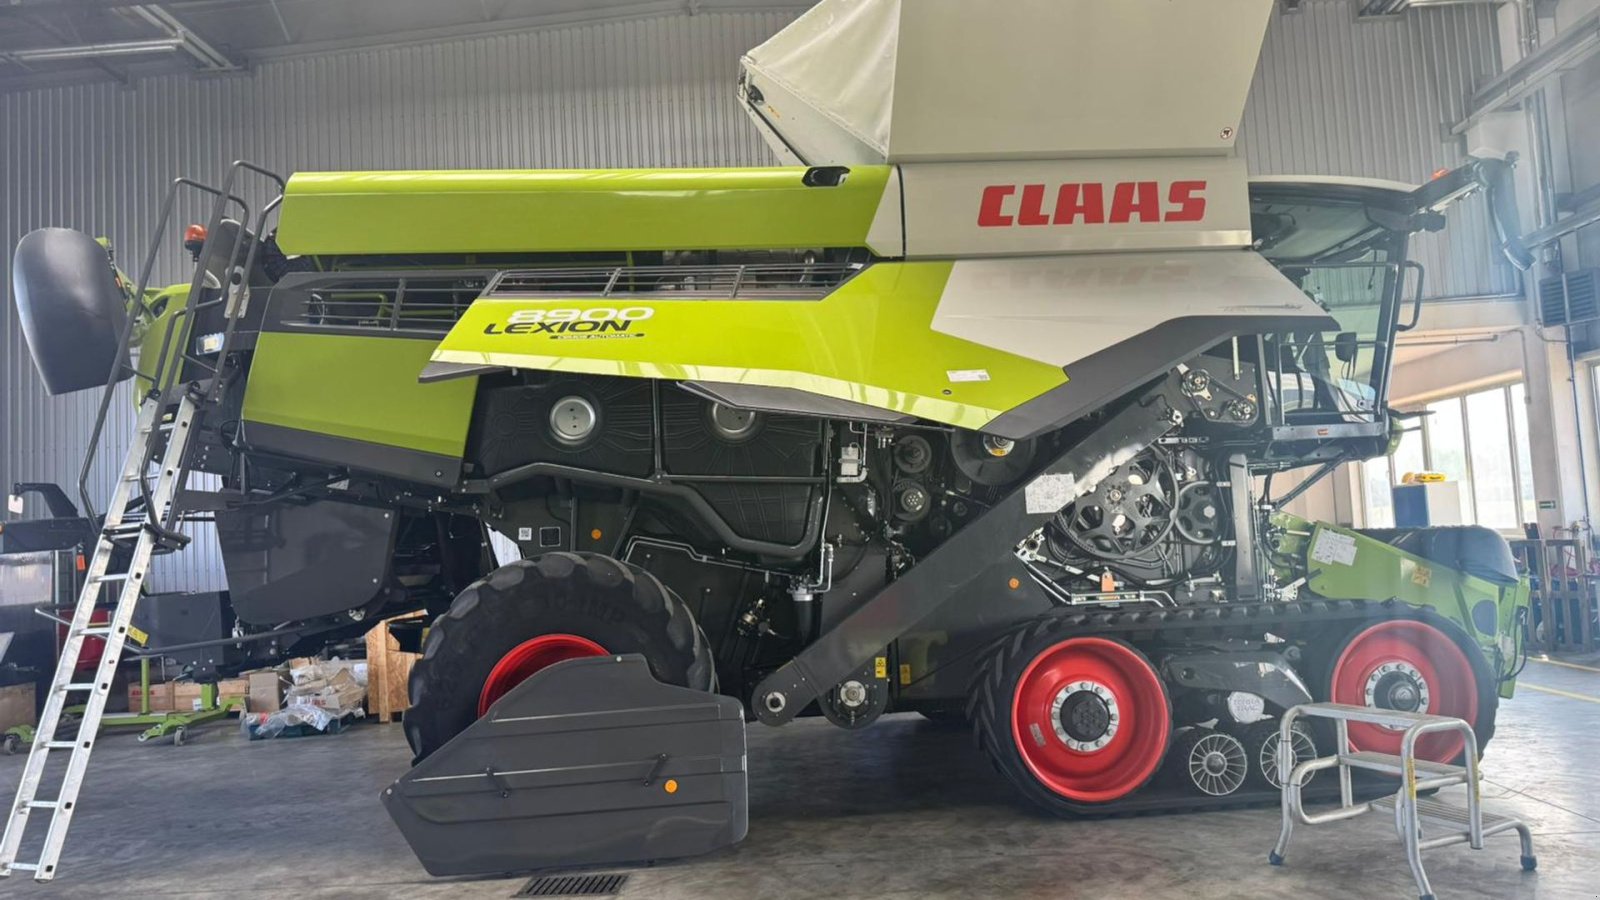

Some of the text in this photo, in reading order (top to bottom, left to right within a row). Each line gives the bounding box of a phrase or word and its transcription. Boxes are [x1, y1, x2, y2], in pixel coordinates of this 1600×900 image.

[977, 181, 1207, 227] CLAAS
[509, 307, 655, 323] 8900
[484, 320, 631, 335] LEXION
